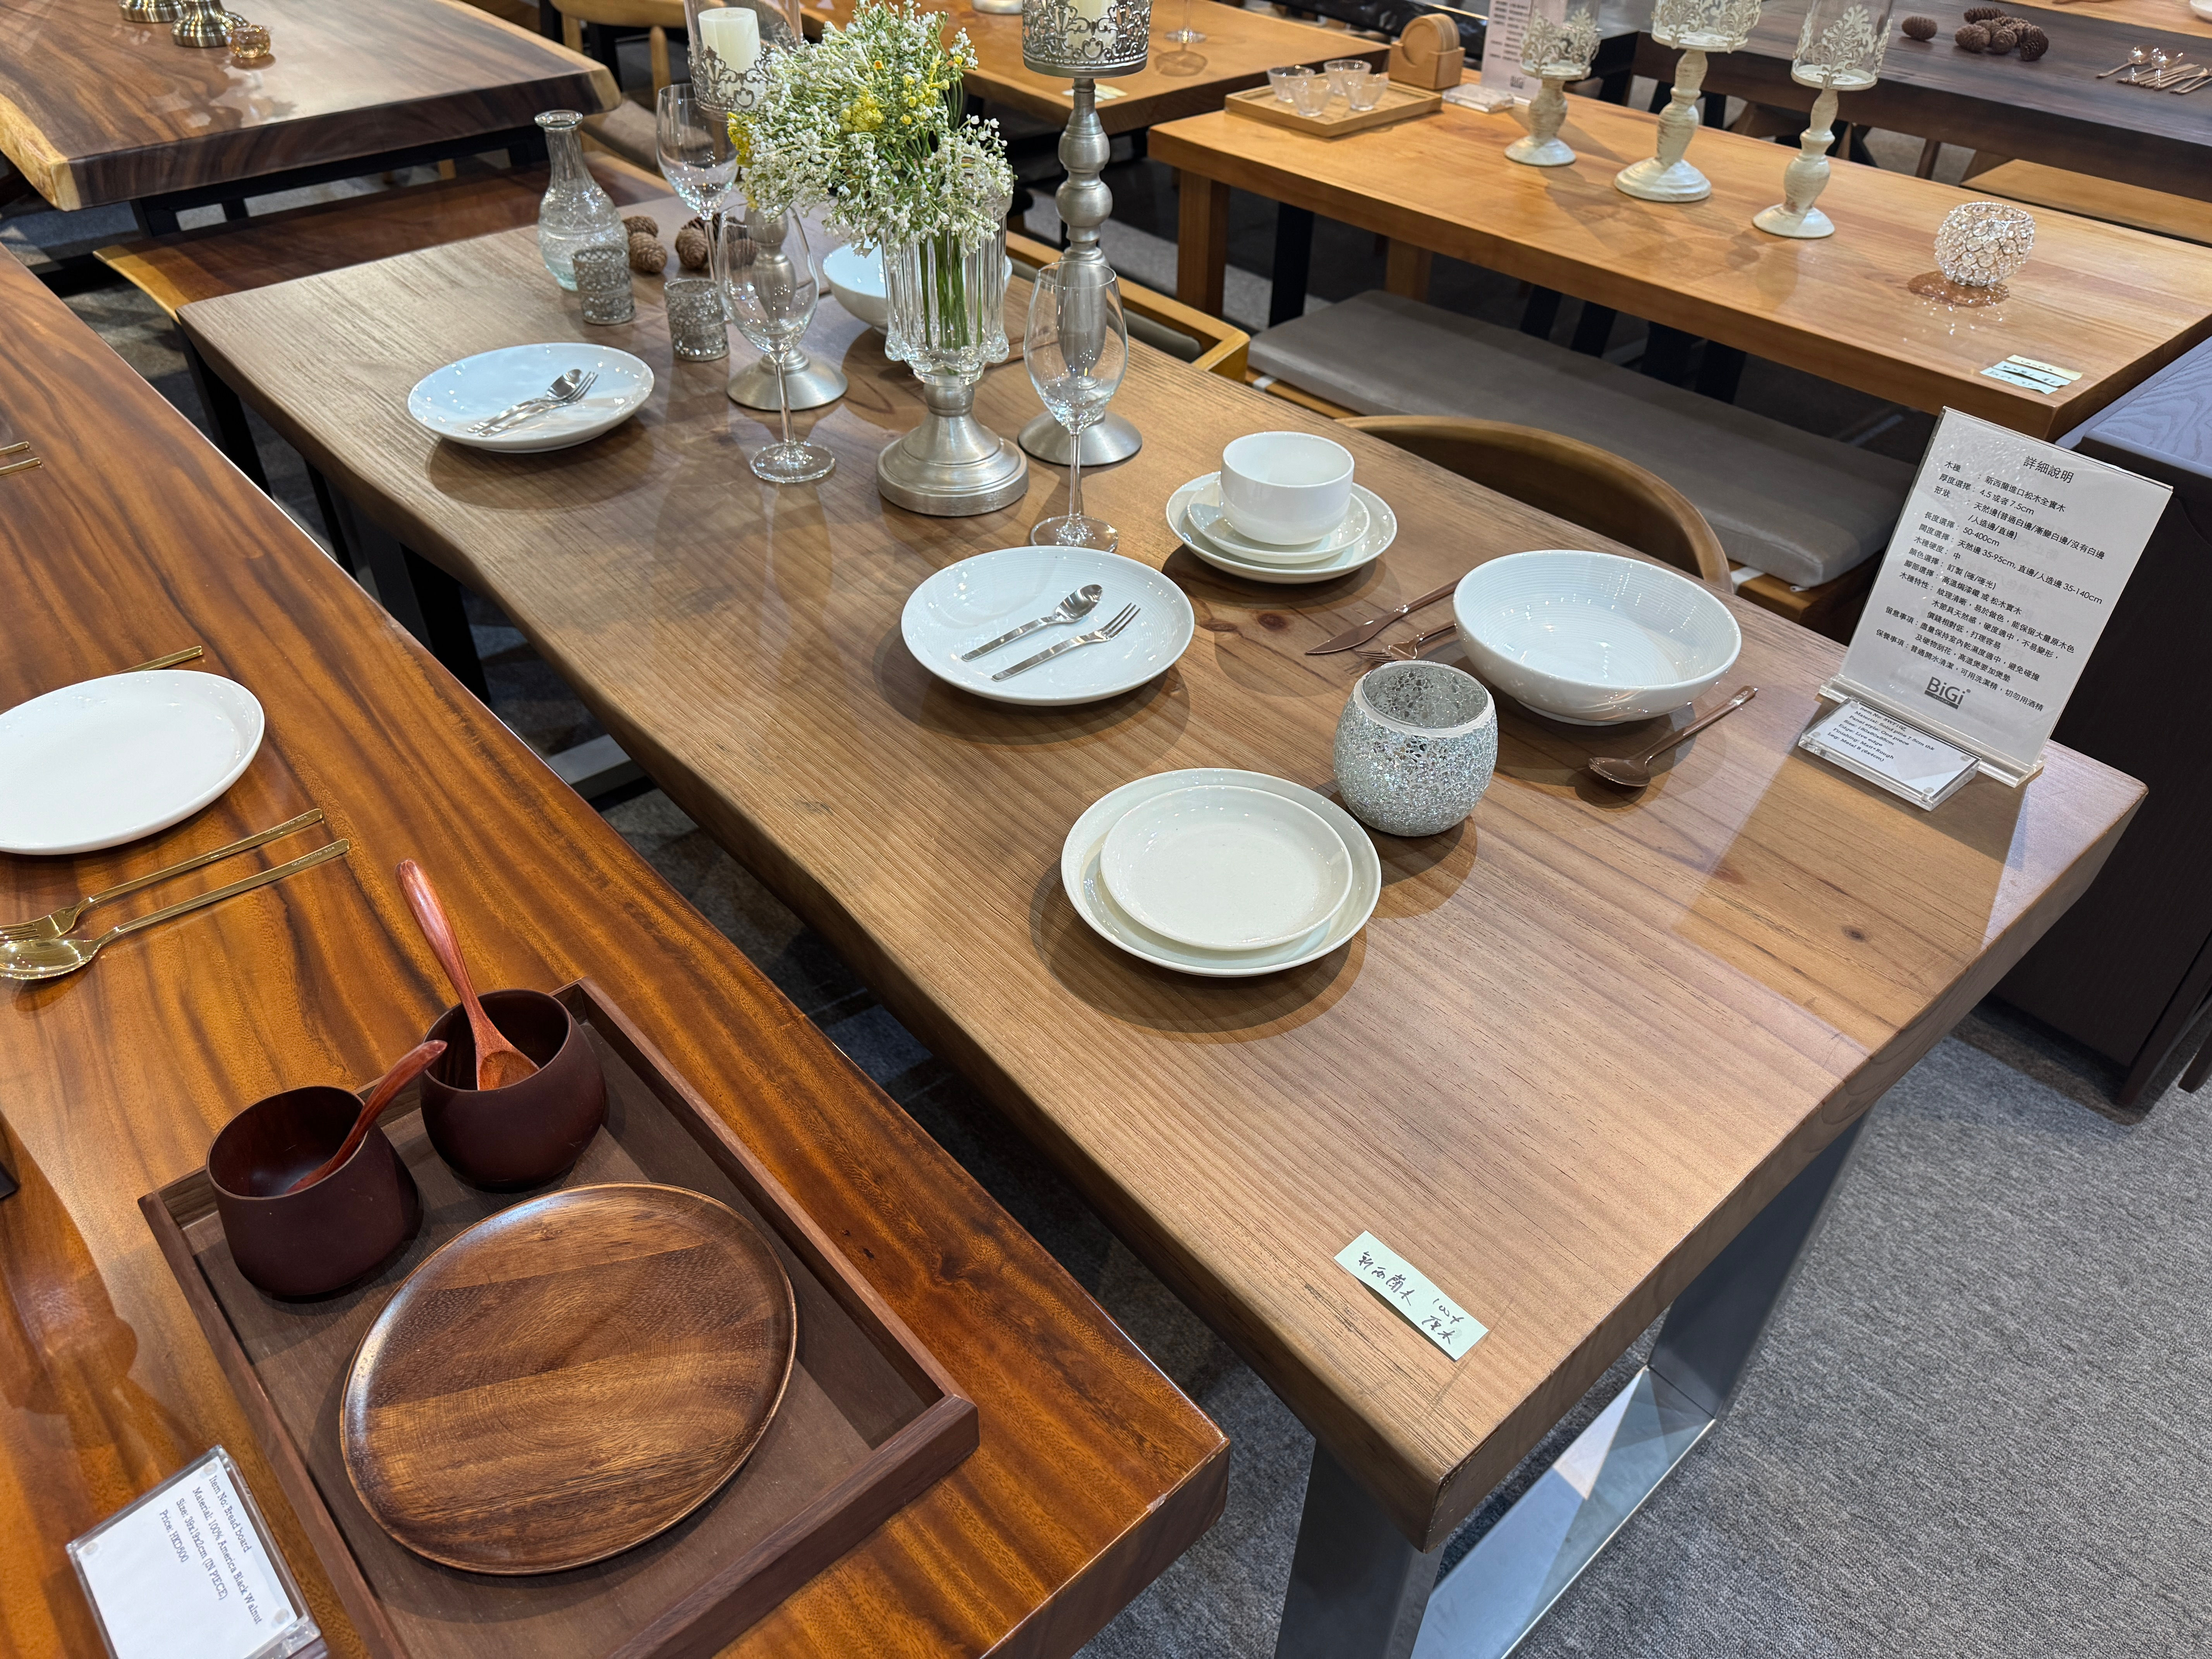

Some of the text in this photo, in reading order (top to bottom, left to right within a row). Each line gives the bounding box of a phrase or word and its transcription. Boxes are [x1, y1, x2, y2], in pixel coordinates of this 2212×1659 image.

[1944, 461, 1961, 472] 木種
[2023, 456, 2074, 483] 詳細說明
[1934, 486, 1950, 498] 形狀
[1980, 489, 1992, 498] 4.5
[1992, 495, 2009, 505] 或者
[2010, 500, 2034, 515] 7.5cm
[1963, 527, 1999, 546] 50-400cm
[1982, 550, 2016, 569] 35-95cm,
[2063, 583, 2102, 604] 35-140cm
[1981, 593, 1989, 601] 或
[1927, 677, 1964, 705] BiGi
[1839, 724, 1855, 733] Edge:
[1849, 716, 1865, 724] Panel
[1893, 737, 1909, 745] piece
[1855, 711, 1879, 724] Material:
[1879, 723, 1894, 731] Solid
[1833, 728, 1860, 742] Finishing:
[1840, 739, 1856, 748] Metal
[176, 1498, 188, 1518] Size:
[209, 1475, 252, 1553] Item No: Bread board
[160, 1509, 173, 1532] Price:
[193, 1486, 262, 1624] Material: 100% America Black Walnut
[203, 1558, 216, 1571] (IN
[209, 1569, 228, 1600] PIECE)
